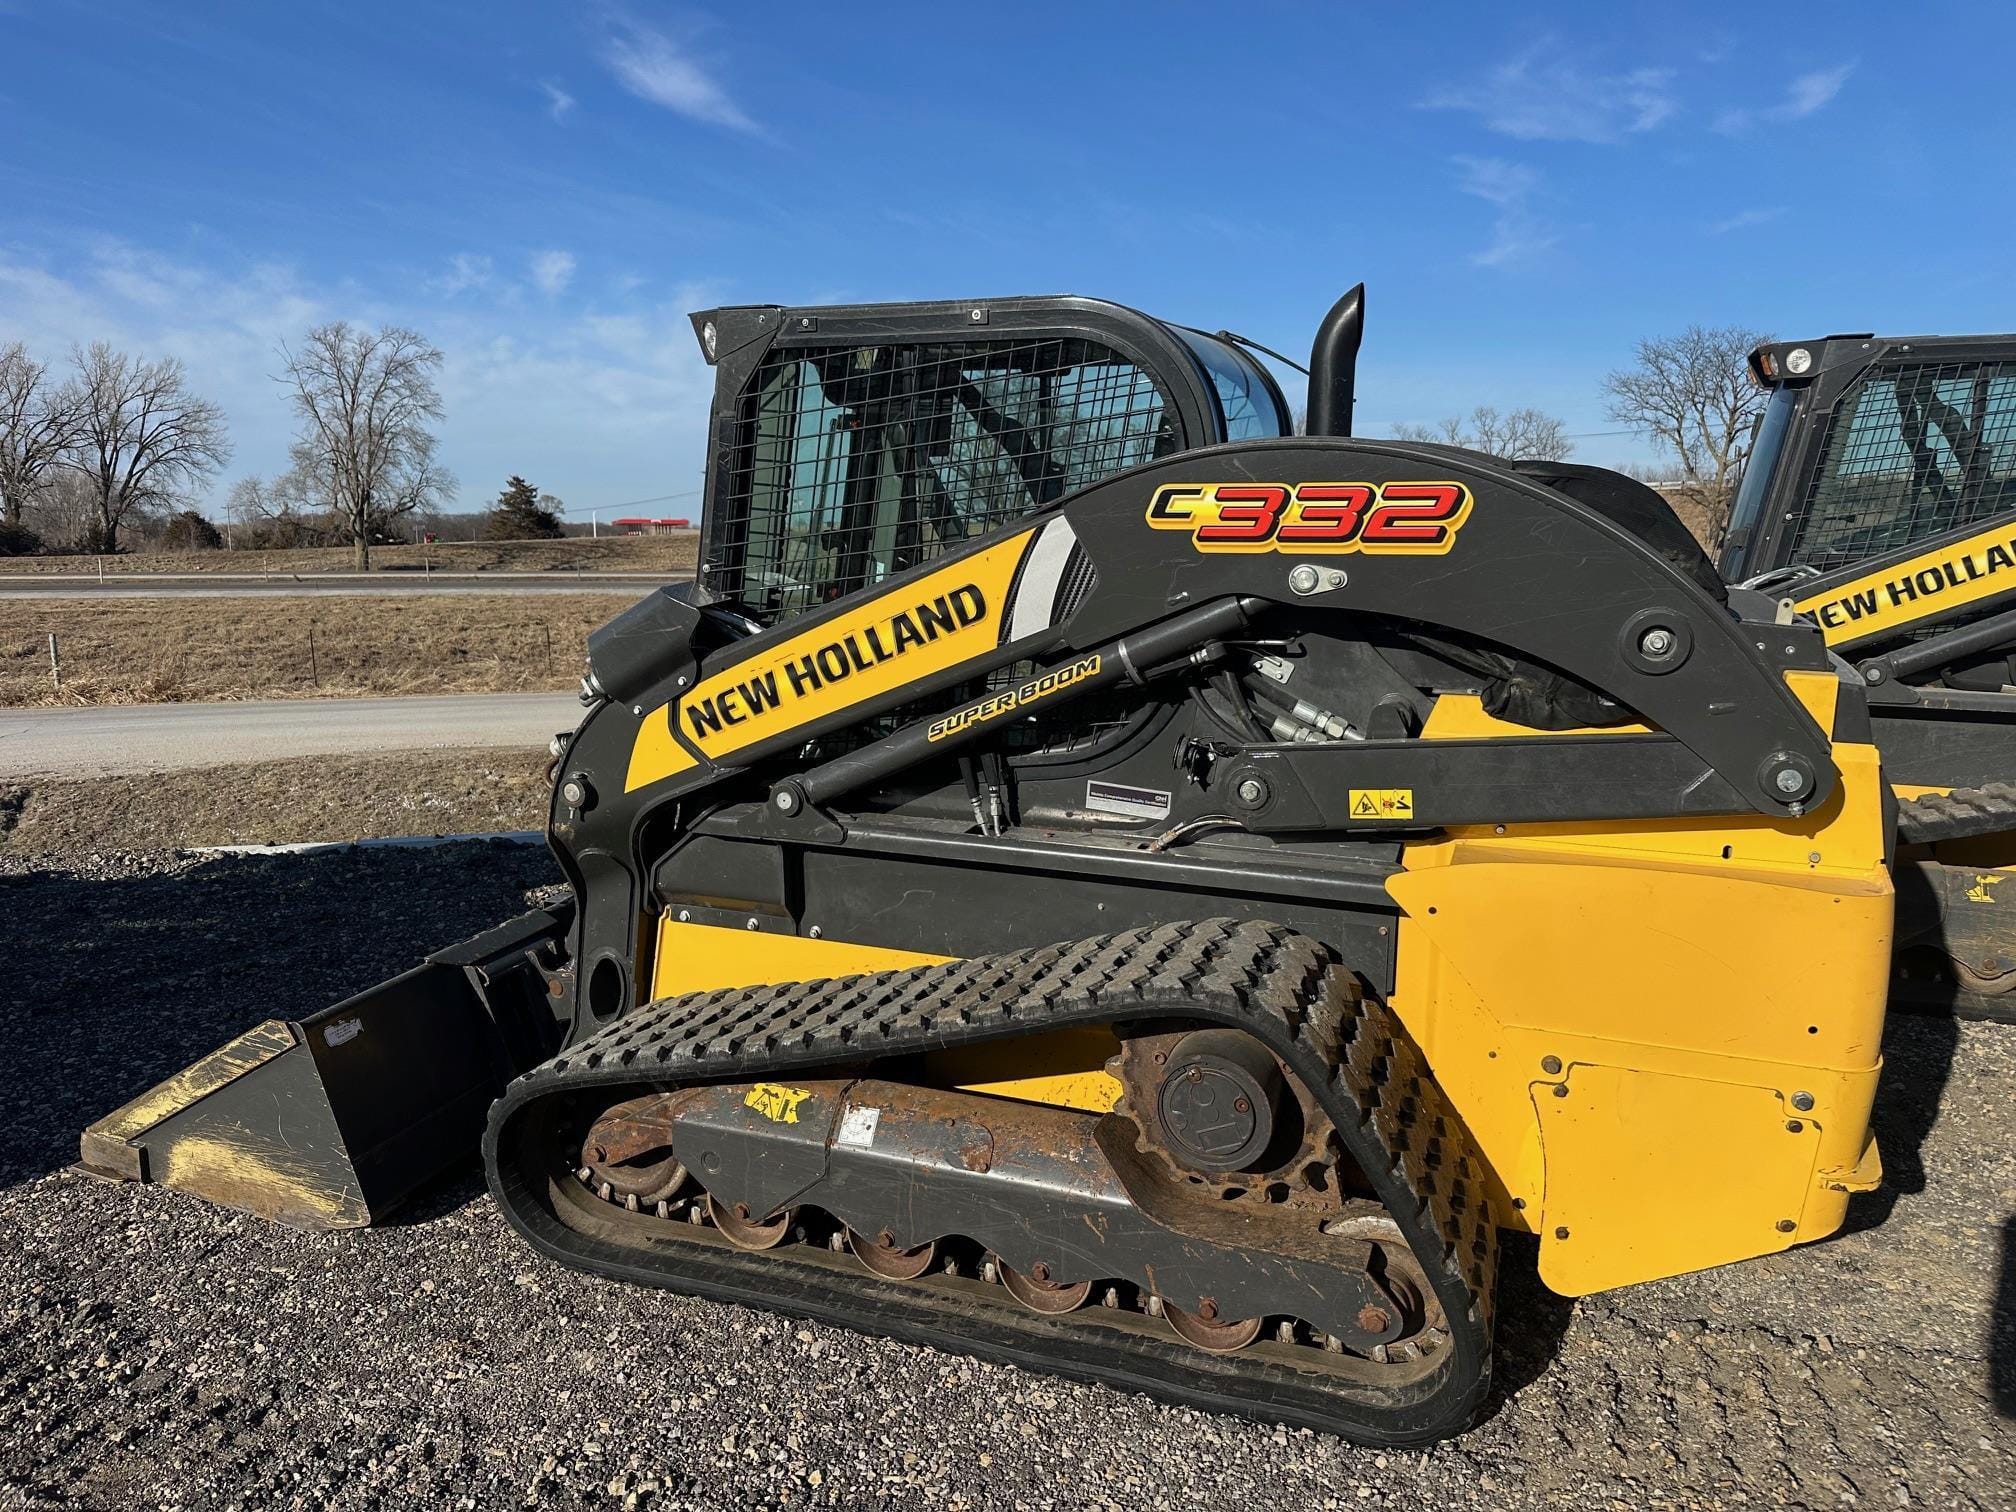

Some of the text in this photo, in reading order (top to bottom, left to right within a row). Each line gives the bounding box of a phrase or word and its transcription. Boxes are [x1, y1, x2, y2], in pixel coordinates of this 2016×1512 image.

[1148, 483, 1471, 551] C332
[1885, 539, 2016, 608] HOLLA
[685, 582, 988, 740] NEW HOLLAND
[928, 655, 1101, 742] SUPER BOOM
